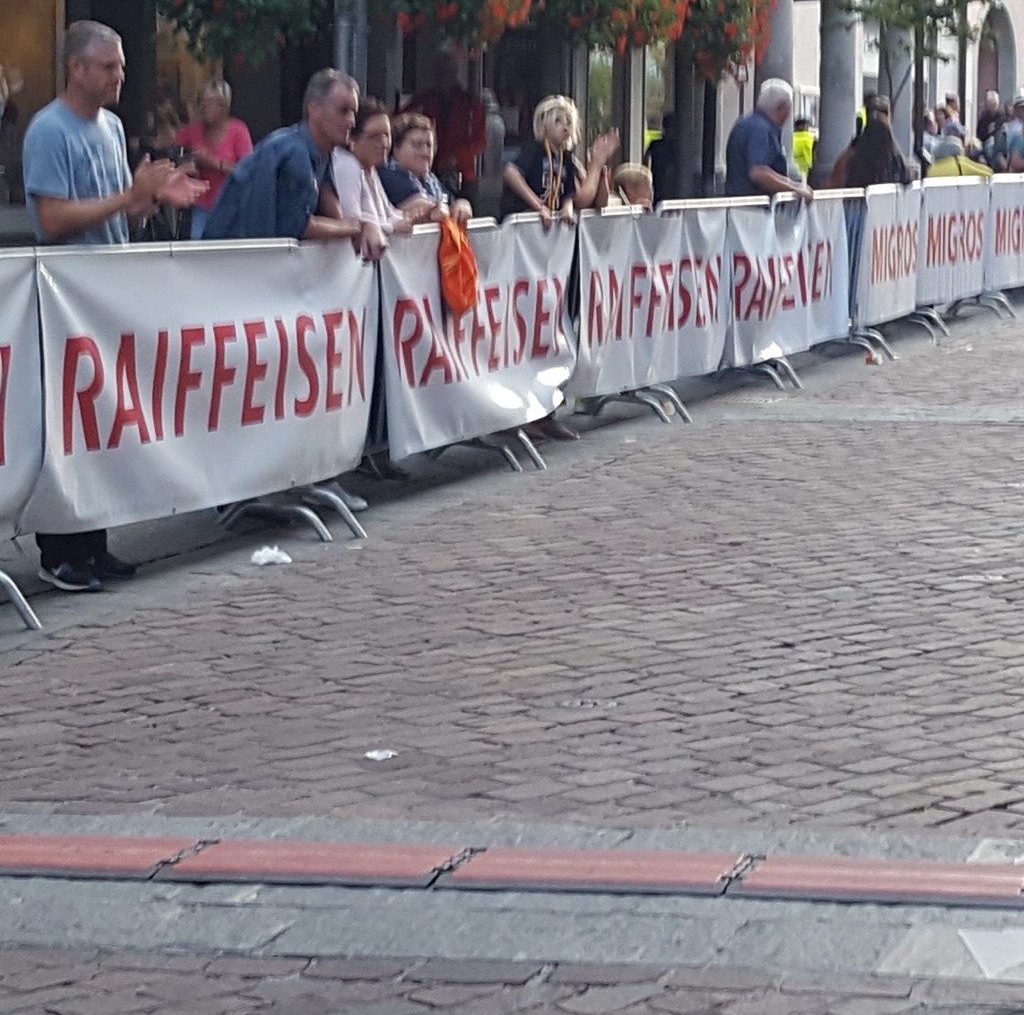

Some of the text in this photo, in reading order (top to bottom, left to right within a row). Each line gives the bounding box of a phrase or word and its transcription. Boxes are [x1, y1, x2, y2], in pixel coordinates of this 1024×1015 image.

[871, 219, 918, 284] MIGROS
[926, 209, 985, 269] MIGROS
[63, 307, 366, 456] RAIFFEISEN
